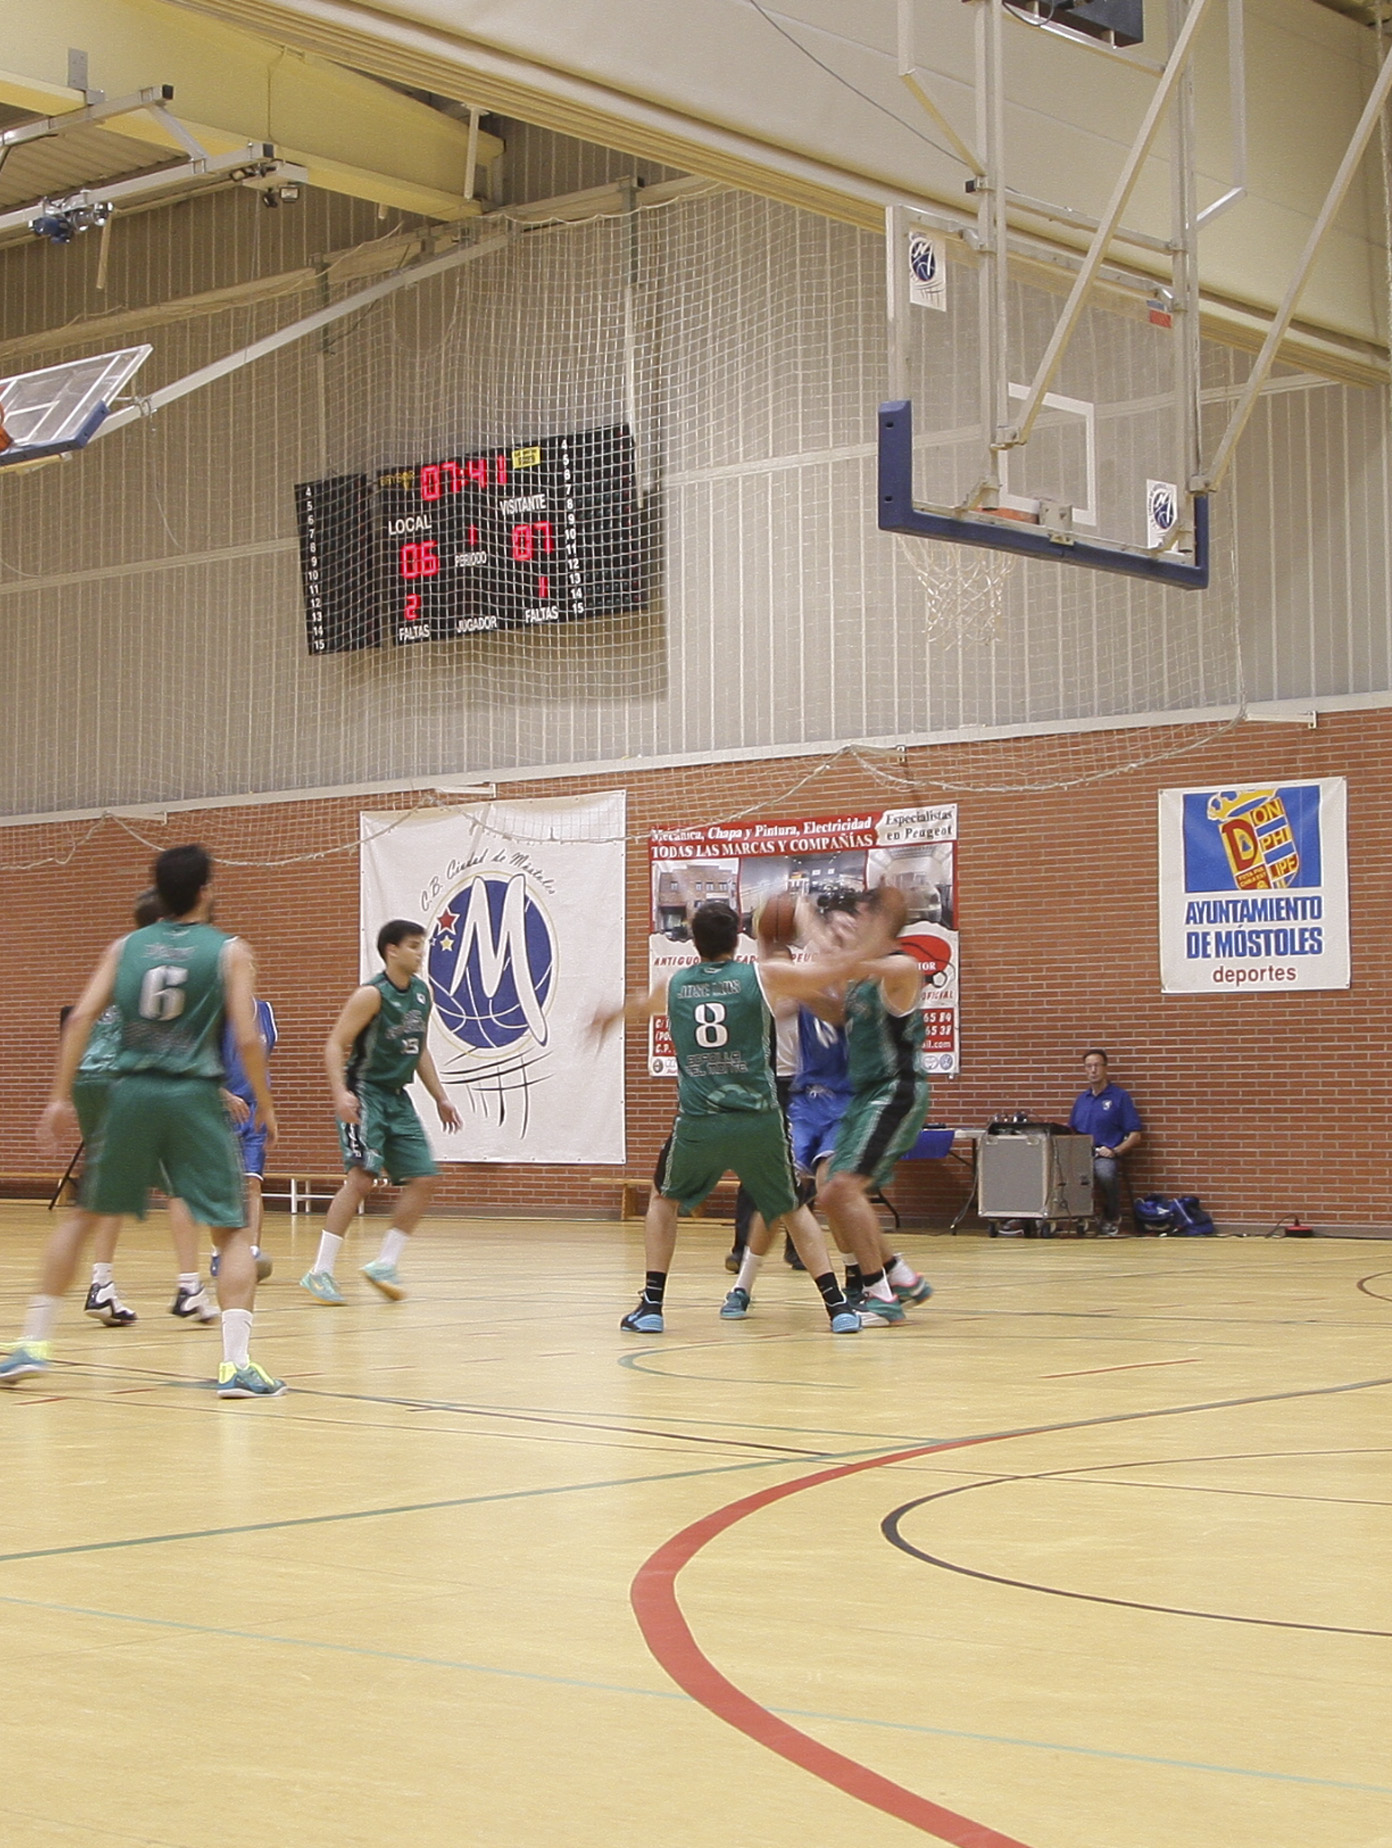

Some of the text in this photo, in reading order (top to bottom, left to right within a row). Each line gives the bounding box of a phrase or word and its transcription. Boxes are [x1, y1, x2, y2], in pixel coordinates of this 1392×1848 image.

[561, 439, 568, 450] 4
[563, 454, 569, 466] 5
[420, 455, 507, 501] 07:41
[563, 469, 571, 480] 6
[305, 487, 311, 496] 4
[565, 484, 572, 495] 7
[307, 502, 313, 511] 5
[500, 494, 546, 516] VISITANTE
[567, 499, 573, 510] 8
[308, 515, 314, 525] 6
[388, 514, 432, 535] LOCAL
[568, 513, 575, 525] 9
[309, 529, 315, 539] 7
[564, 528, 576, 540] 10
[310, 542, 316, 552] 8
[512, 521, 553, 561] 07
[565, 544, 577, 555] 11
[311, 556, 317, 566] 9
[401, 541, 440, 578] 06
[455, 551, 487, 567] PERIODO
[568, 558, 579, 570] 12
[308, 571, 319, 580] 10
[569, 573, 581, 584] 13
[309, 585, 319, 594] 11
[571, 587, 582, 599] 14
[310, 598, 321, 608] 12
[404, 593, 421, 620] 2
[572, 602, 584, 614] 15
[312, 612, 322, 622] 13
[525, 606, 558, 623] FALTAS
[456, 616, 498, 633] JUGADOR
[313, 626, 323, 636] 14
[399, 624, 430, 641] FALTAS
[314, 640, 325, 650] 15
[886, 809, 953, 828] Especialistas
[708, 826, 743, 841] Chapa
[744, 828, 753, 840] y
[755, 823, 800, 837] Pintura,
[803, 817, 872, 836] Electricidad
[887, 825, 952, 841] en Peugeot
[651, 831, 873, 858] TODAS LAS MARCAS Y COMPAÑÍAS
[491, 849, 506, 862] de
[1185, 896, 1323, 925] AYUNTAMIENTO
[1186, 924, 1323, 959] DE MÓSTOLES
[654, 955, 701, 966] ANTIGUO
[1213, 966, 1297, 986] deportes
[139, 965, 188, 1021] 6
[694, 1002, 728, 1049] 8
